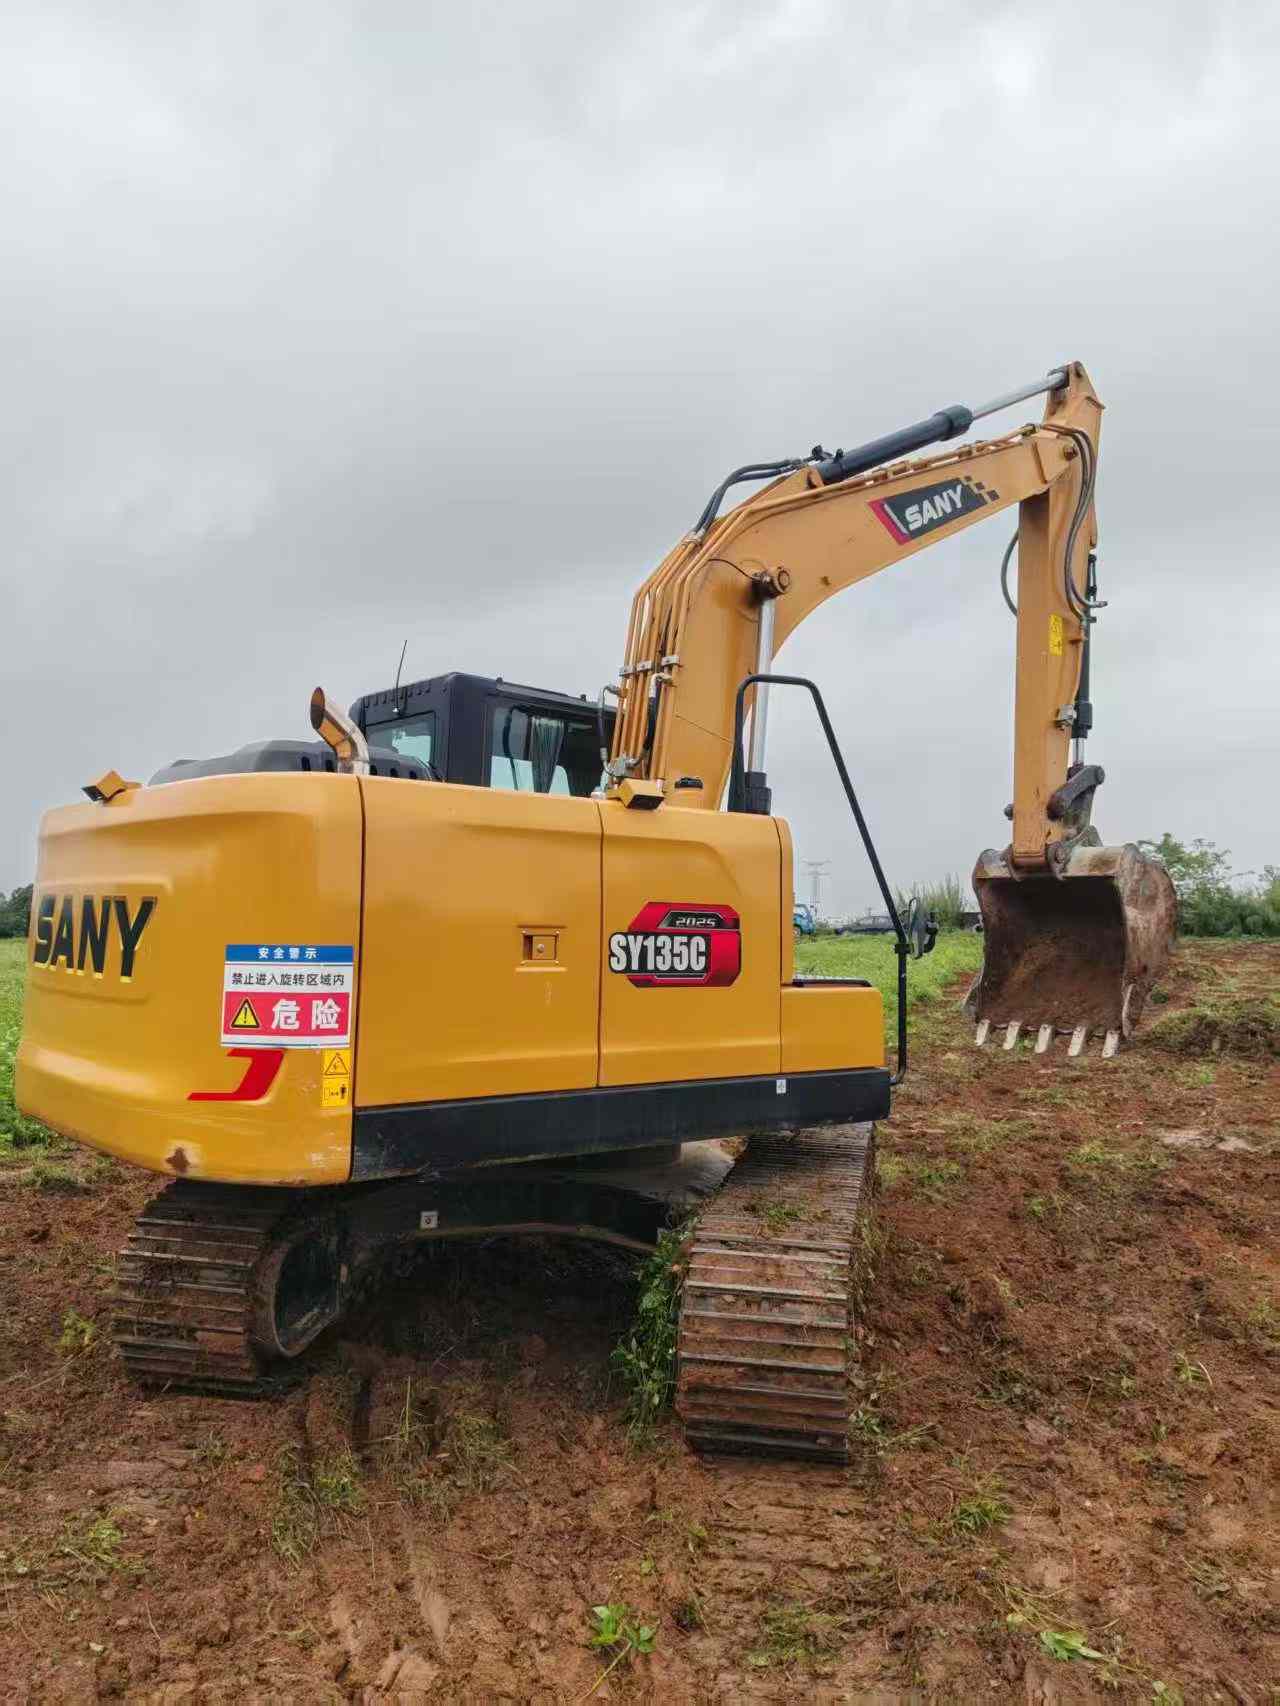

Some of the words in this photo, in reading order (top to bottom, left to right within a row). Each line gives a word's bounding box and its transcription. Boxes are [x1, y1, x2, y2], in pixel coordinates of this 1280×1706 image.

[905, 484, 963, 531] SANY
[33, 896, 157, 982] SANY
[257, 947, 319, 959] 安全警示
[610, 933, 706, 971] SY135C
[231, 973, 345, 986] 禁止进入旋转区域内
[271, 998, 341, 1030] 危险
